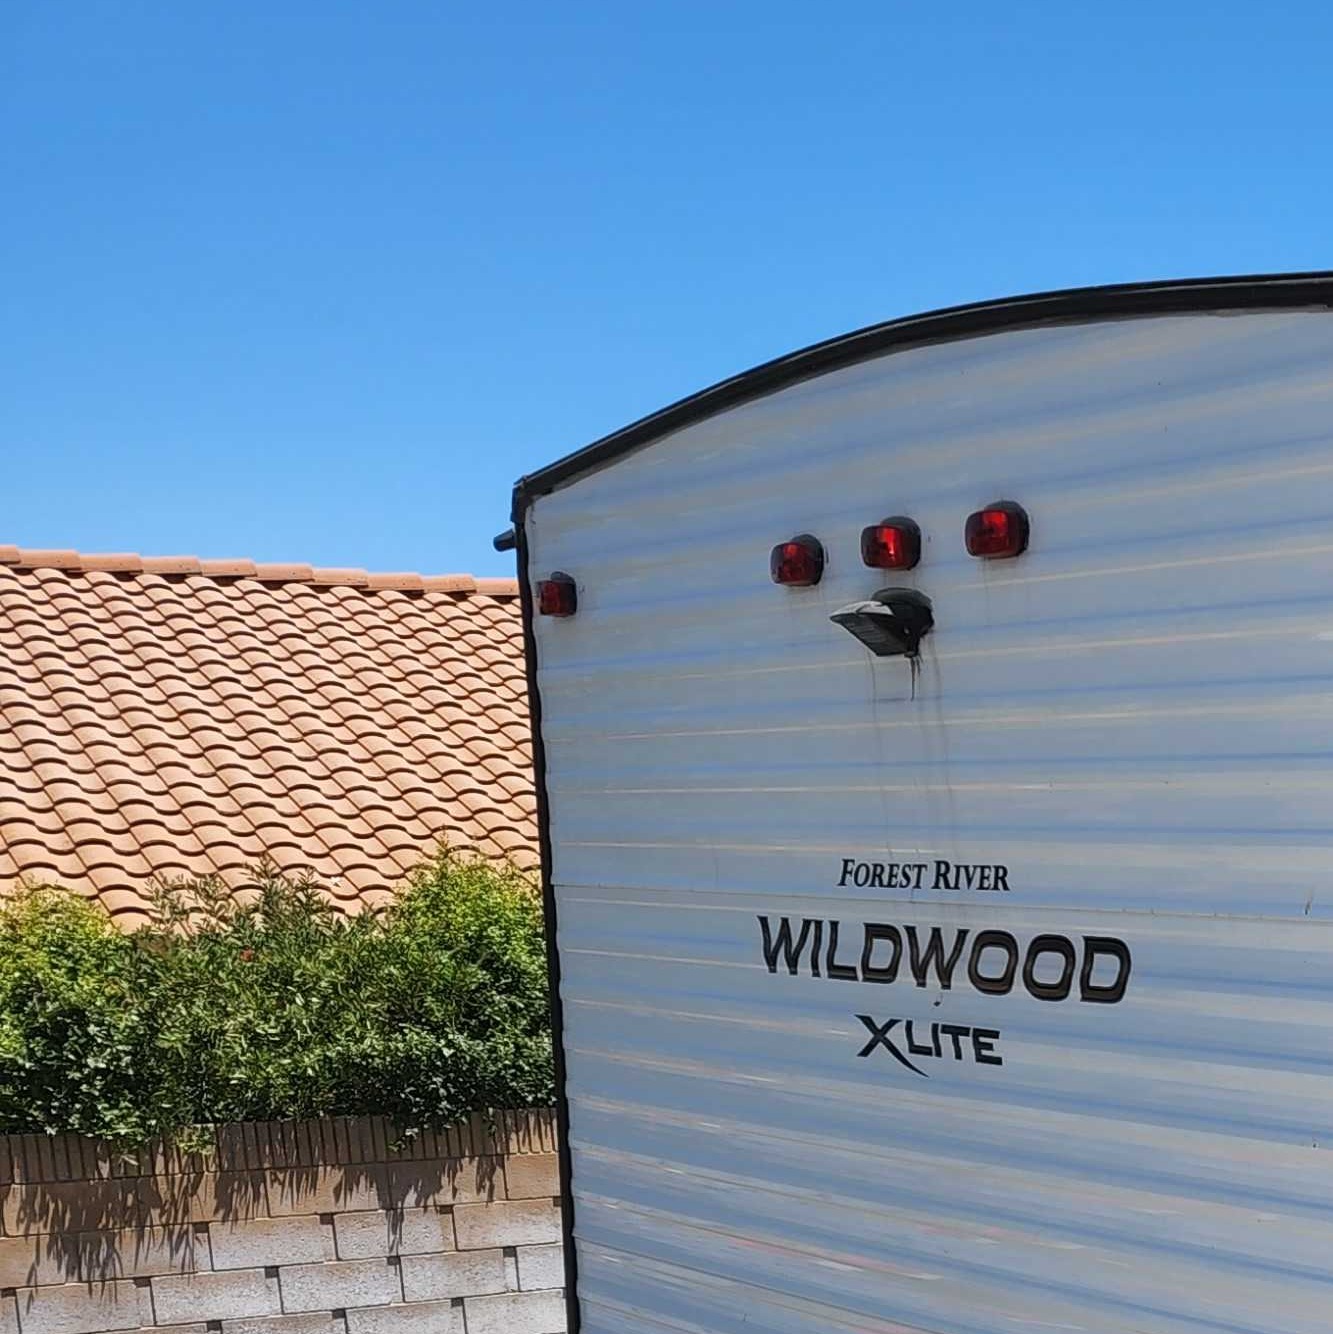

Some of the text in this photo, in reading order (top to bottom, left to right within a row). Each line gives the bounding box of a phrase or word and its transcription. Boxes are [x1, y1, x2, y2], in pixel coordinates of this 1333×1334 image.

[837, 859, 1011, 892] FOREST RIVER
[757, 915, 1132, 1005] WILDWOOD
